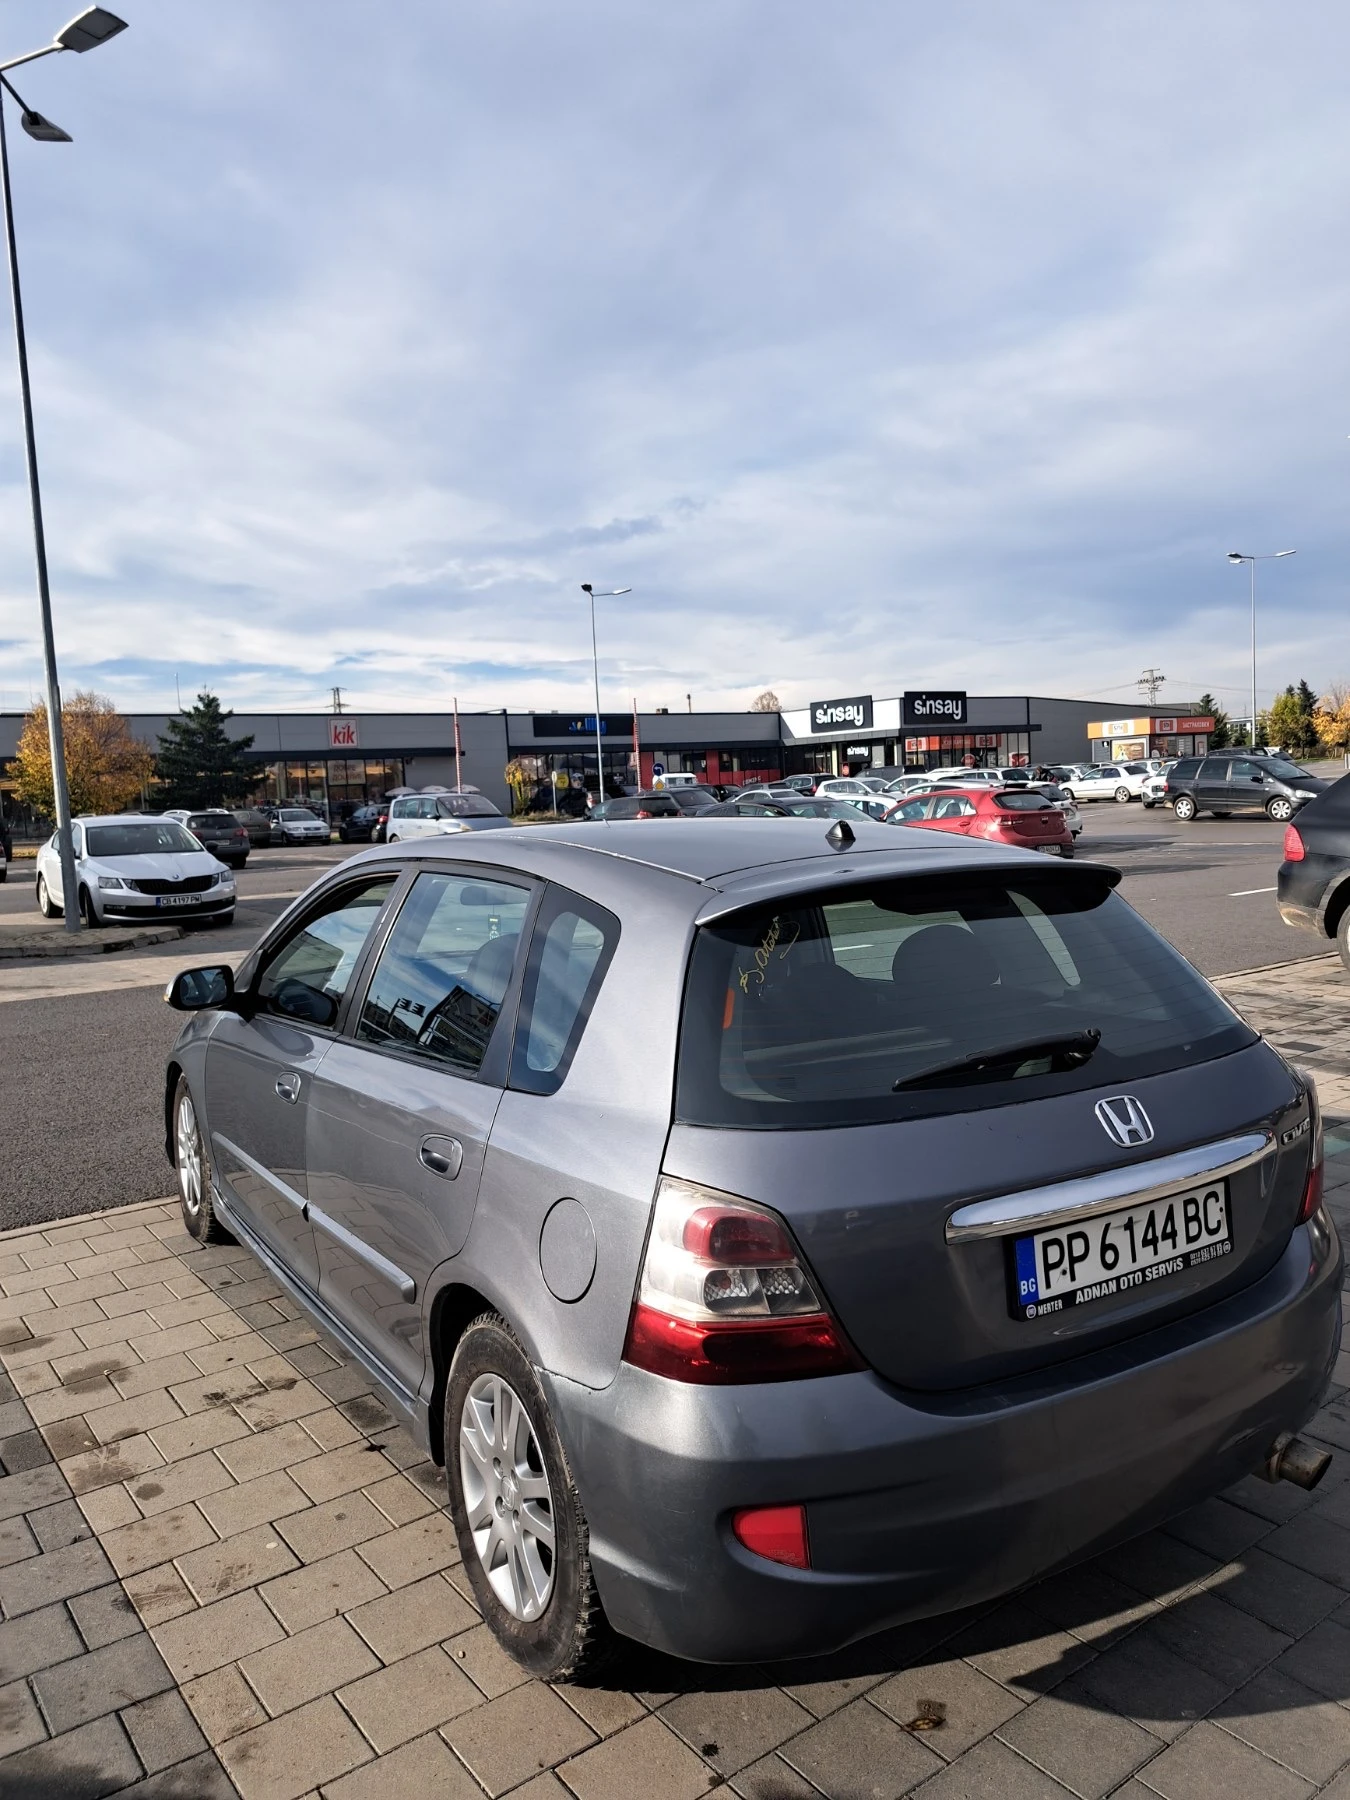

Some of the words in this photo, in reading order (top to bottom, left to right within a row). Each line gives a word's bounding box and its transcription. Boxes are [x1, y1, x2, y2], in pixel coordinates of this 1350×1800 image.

[815, 704, 864, 726] sinsay
[914, 695, 963, 720] sinsay
[333, 722, 355, 744] kik
[1100, 1203, 1178, 1271] 6144
[1183, 1190, 1222, 1245] BC
[1020, 1277, 1037, 1296] BG
[1075, 1281, 1117, 1305] ADNAN
[1120, 1271, 1142, 1290] OTO
